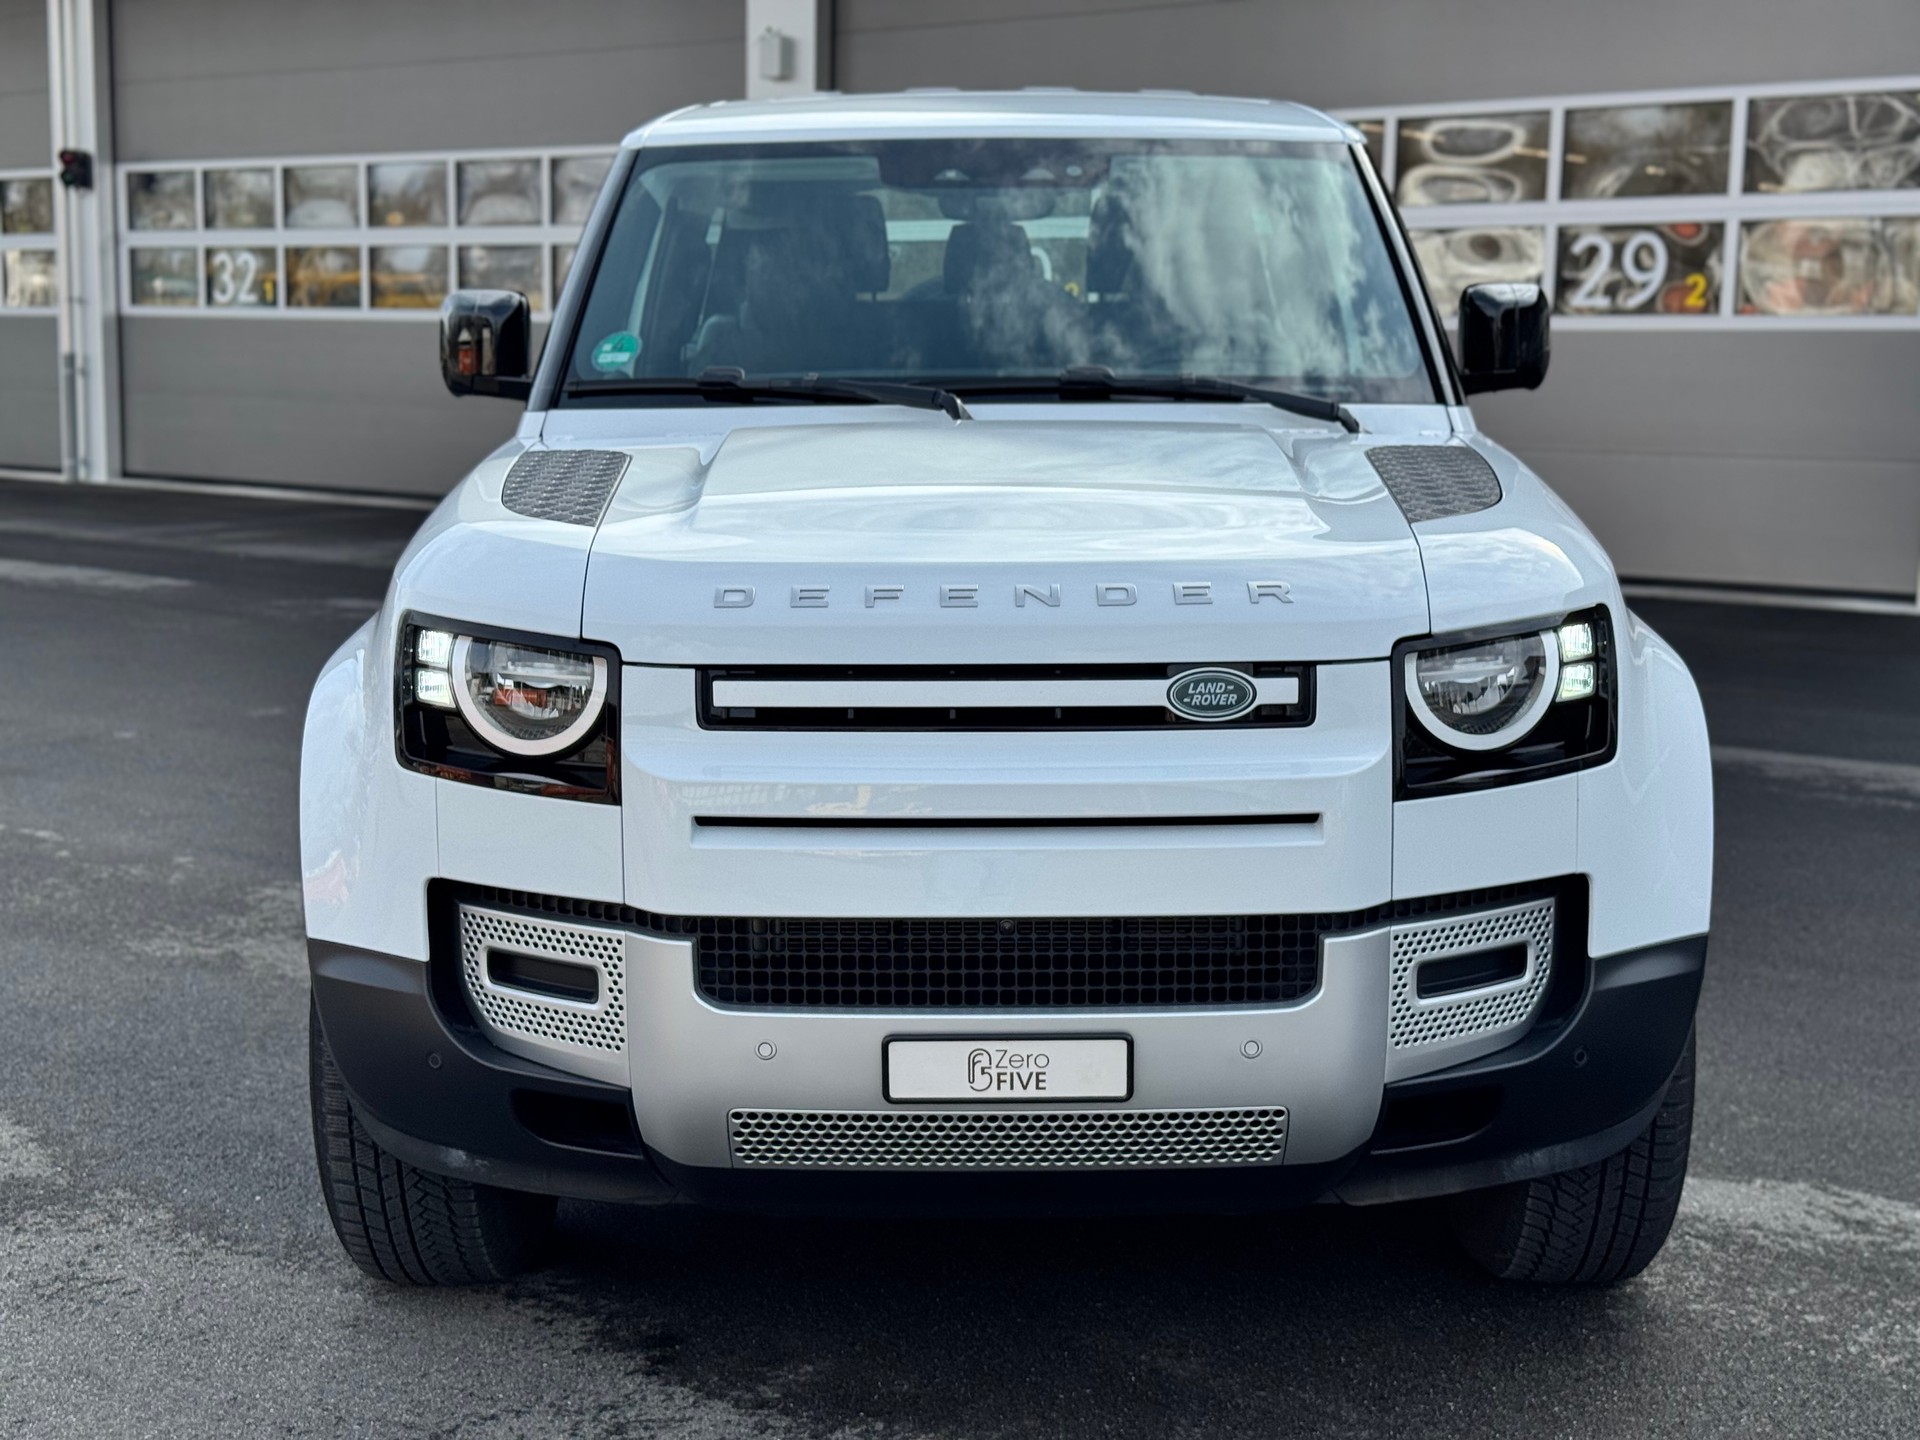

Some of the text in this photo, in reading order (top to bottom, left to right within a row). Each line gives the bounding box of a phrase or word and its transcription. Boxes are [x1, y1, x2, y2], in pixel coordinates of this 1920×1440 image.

[212, 251, 274, 304] 32 1
[1570, 230, 1707, 309] 29 2
[714, 580, 1294, 609] DEFENDER
[995, 1049, 1050, 1069] Zero
[996, 1071, 1047, 1091] FIVE
